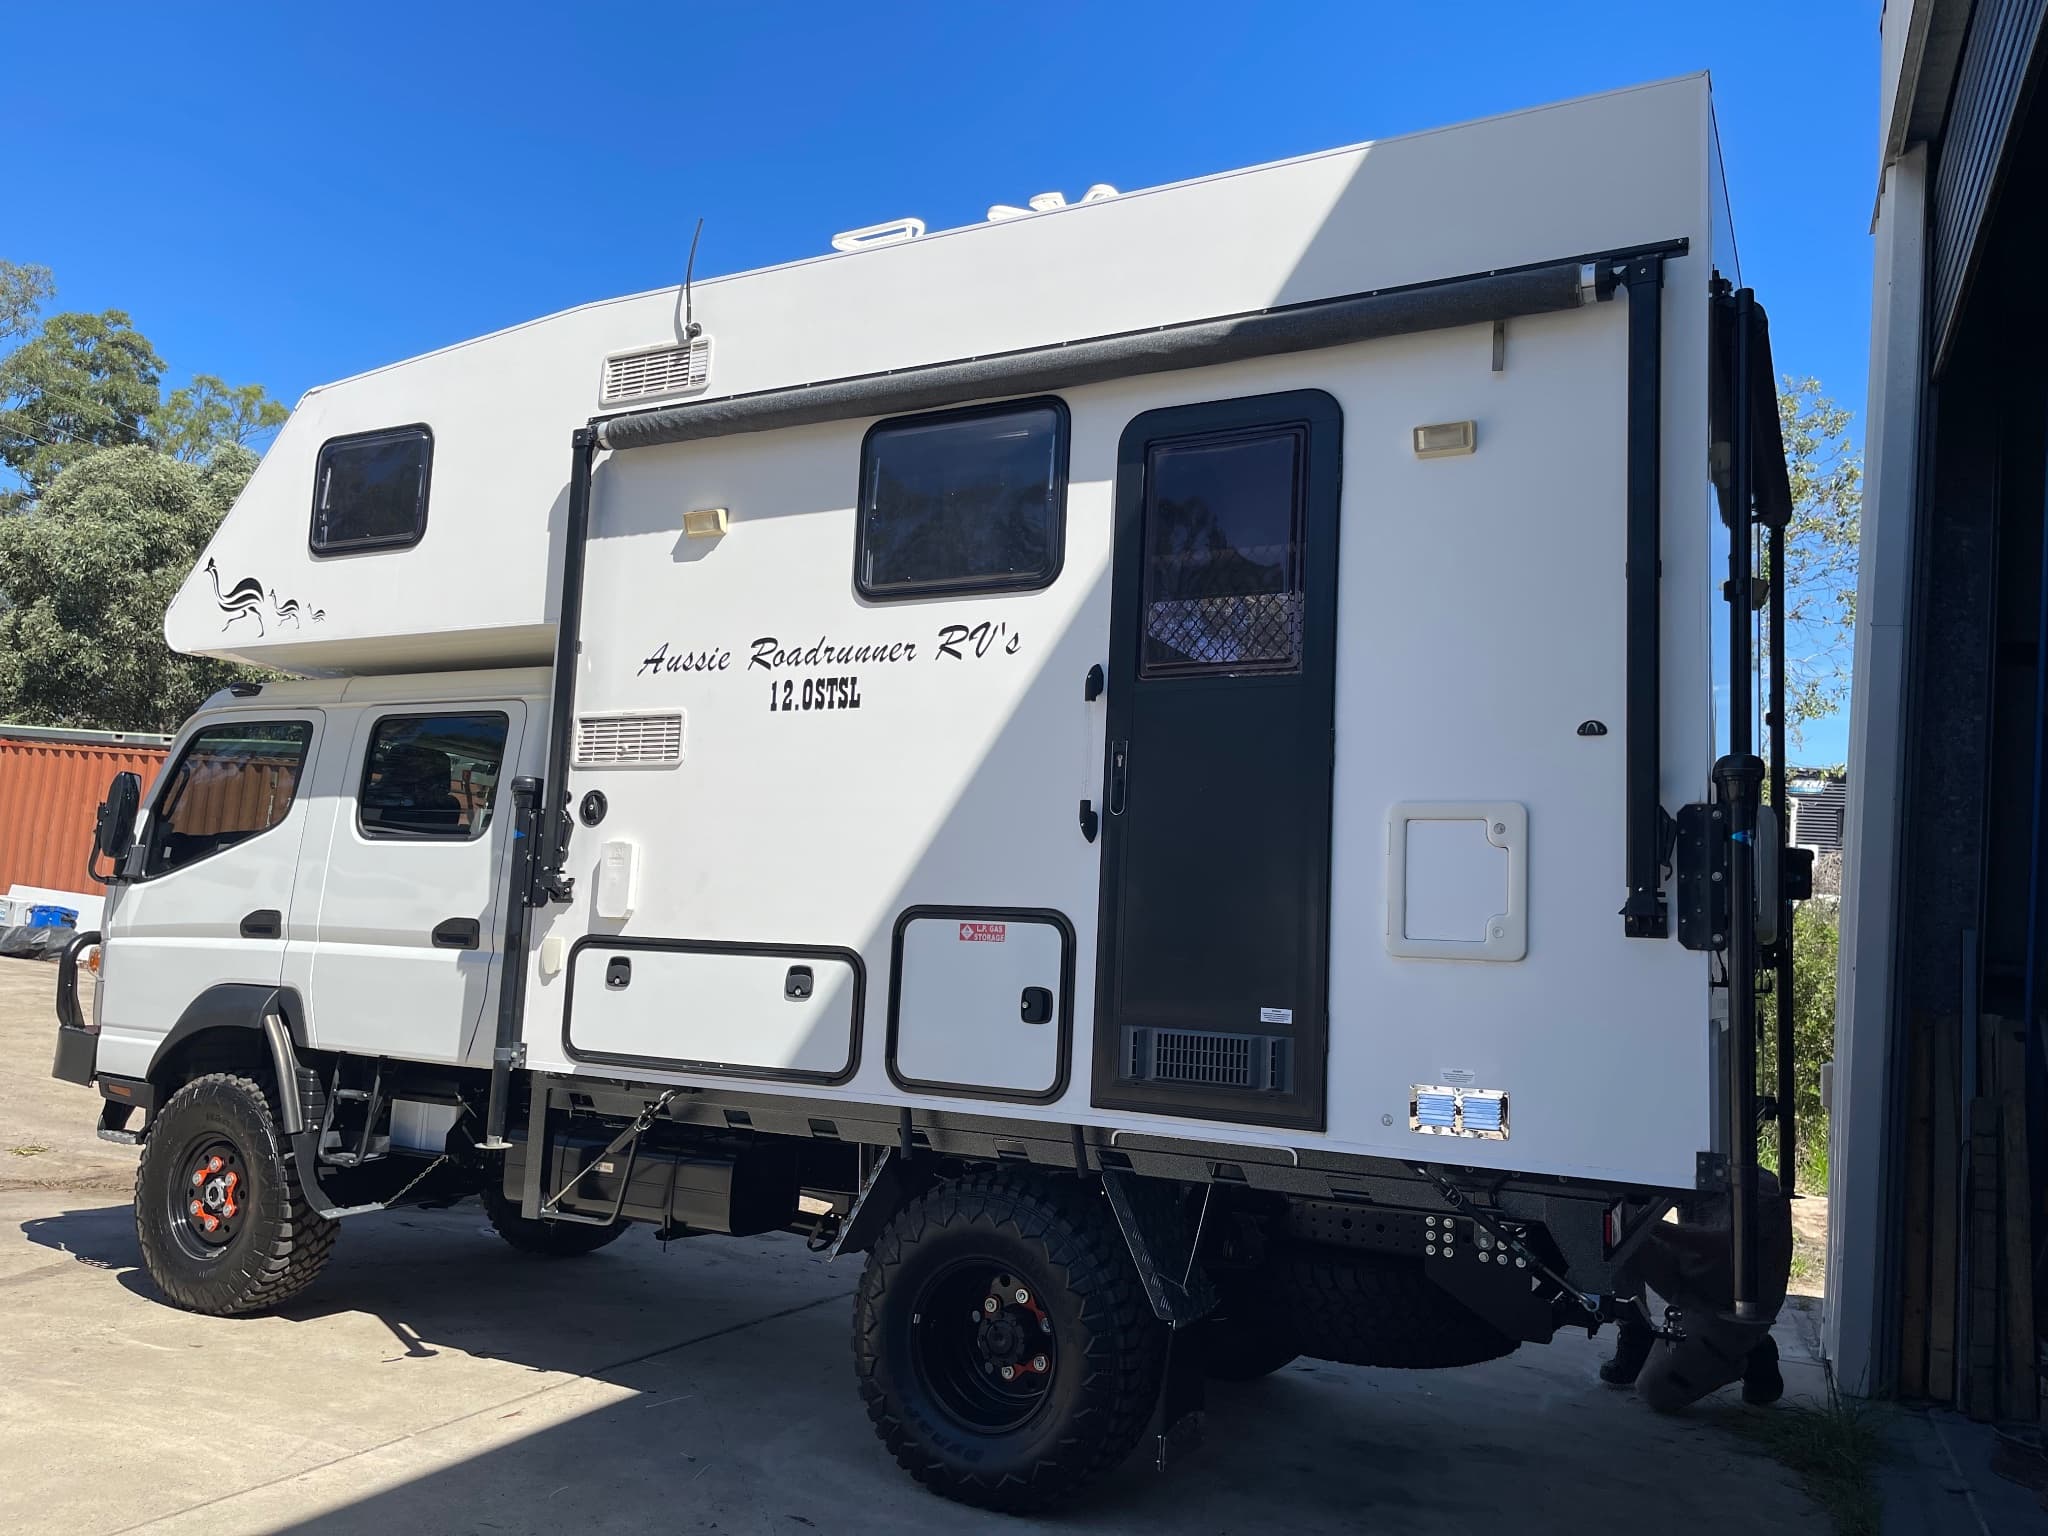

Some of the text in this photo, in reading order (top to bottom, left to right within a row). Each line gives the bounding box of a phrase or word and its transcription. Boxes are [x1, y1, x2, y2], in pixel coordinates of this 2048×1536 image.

[637, 621, 1020, 676] Aussie Roadrunner RV's
[989, 925, 1003, 933] GAS
[974, 933, 1005, 941] STORAGE
